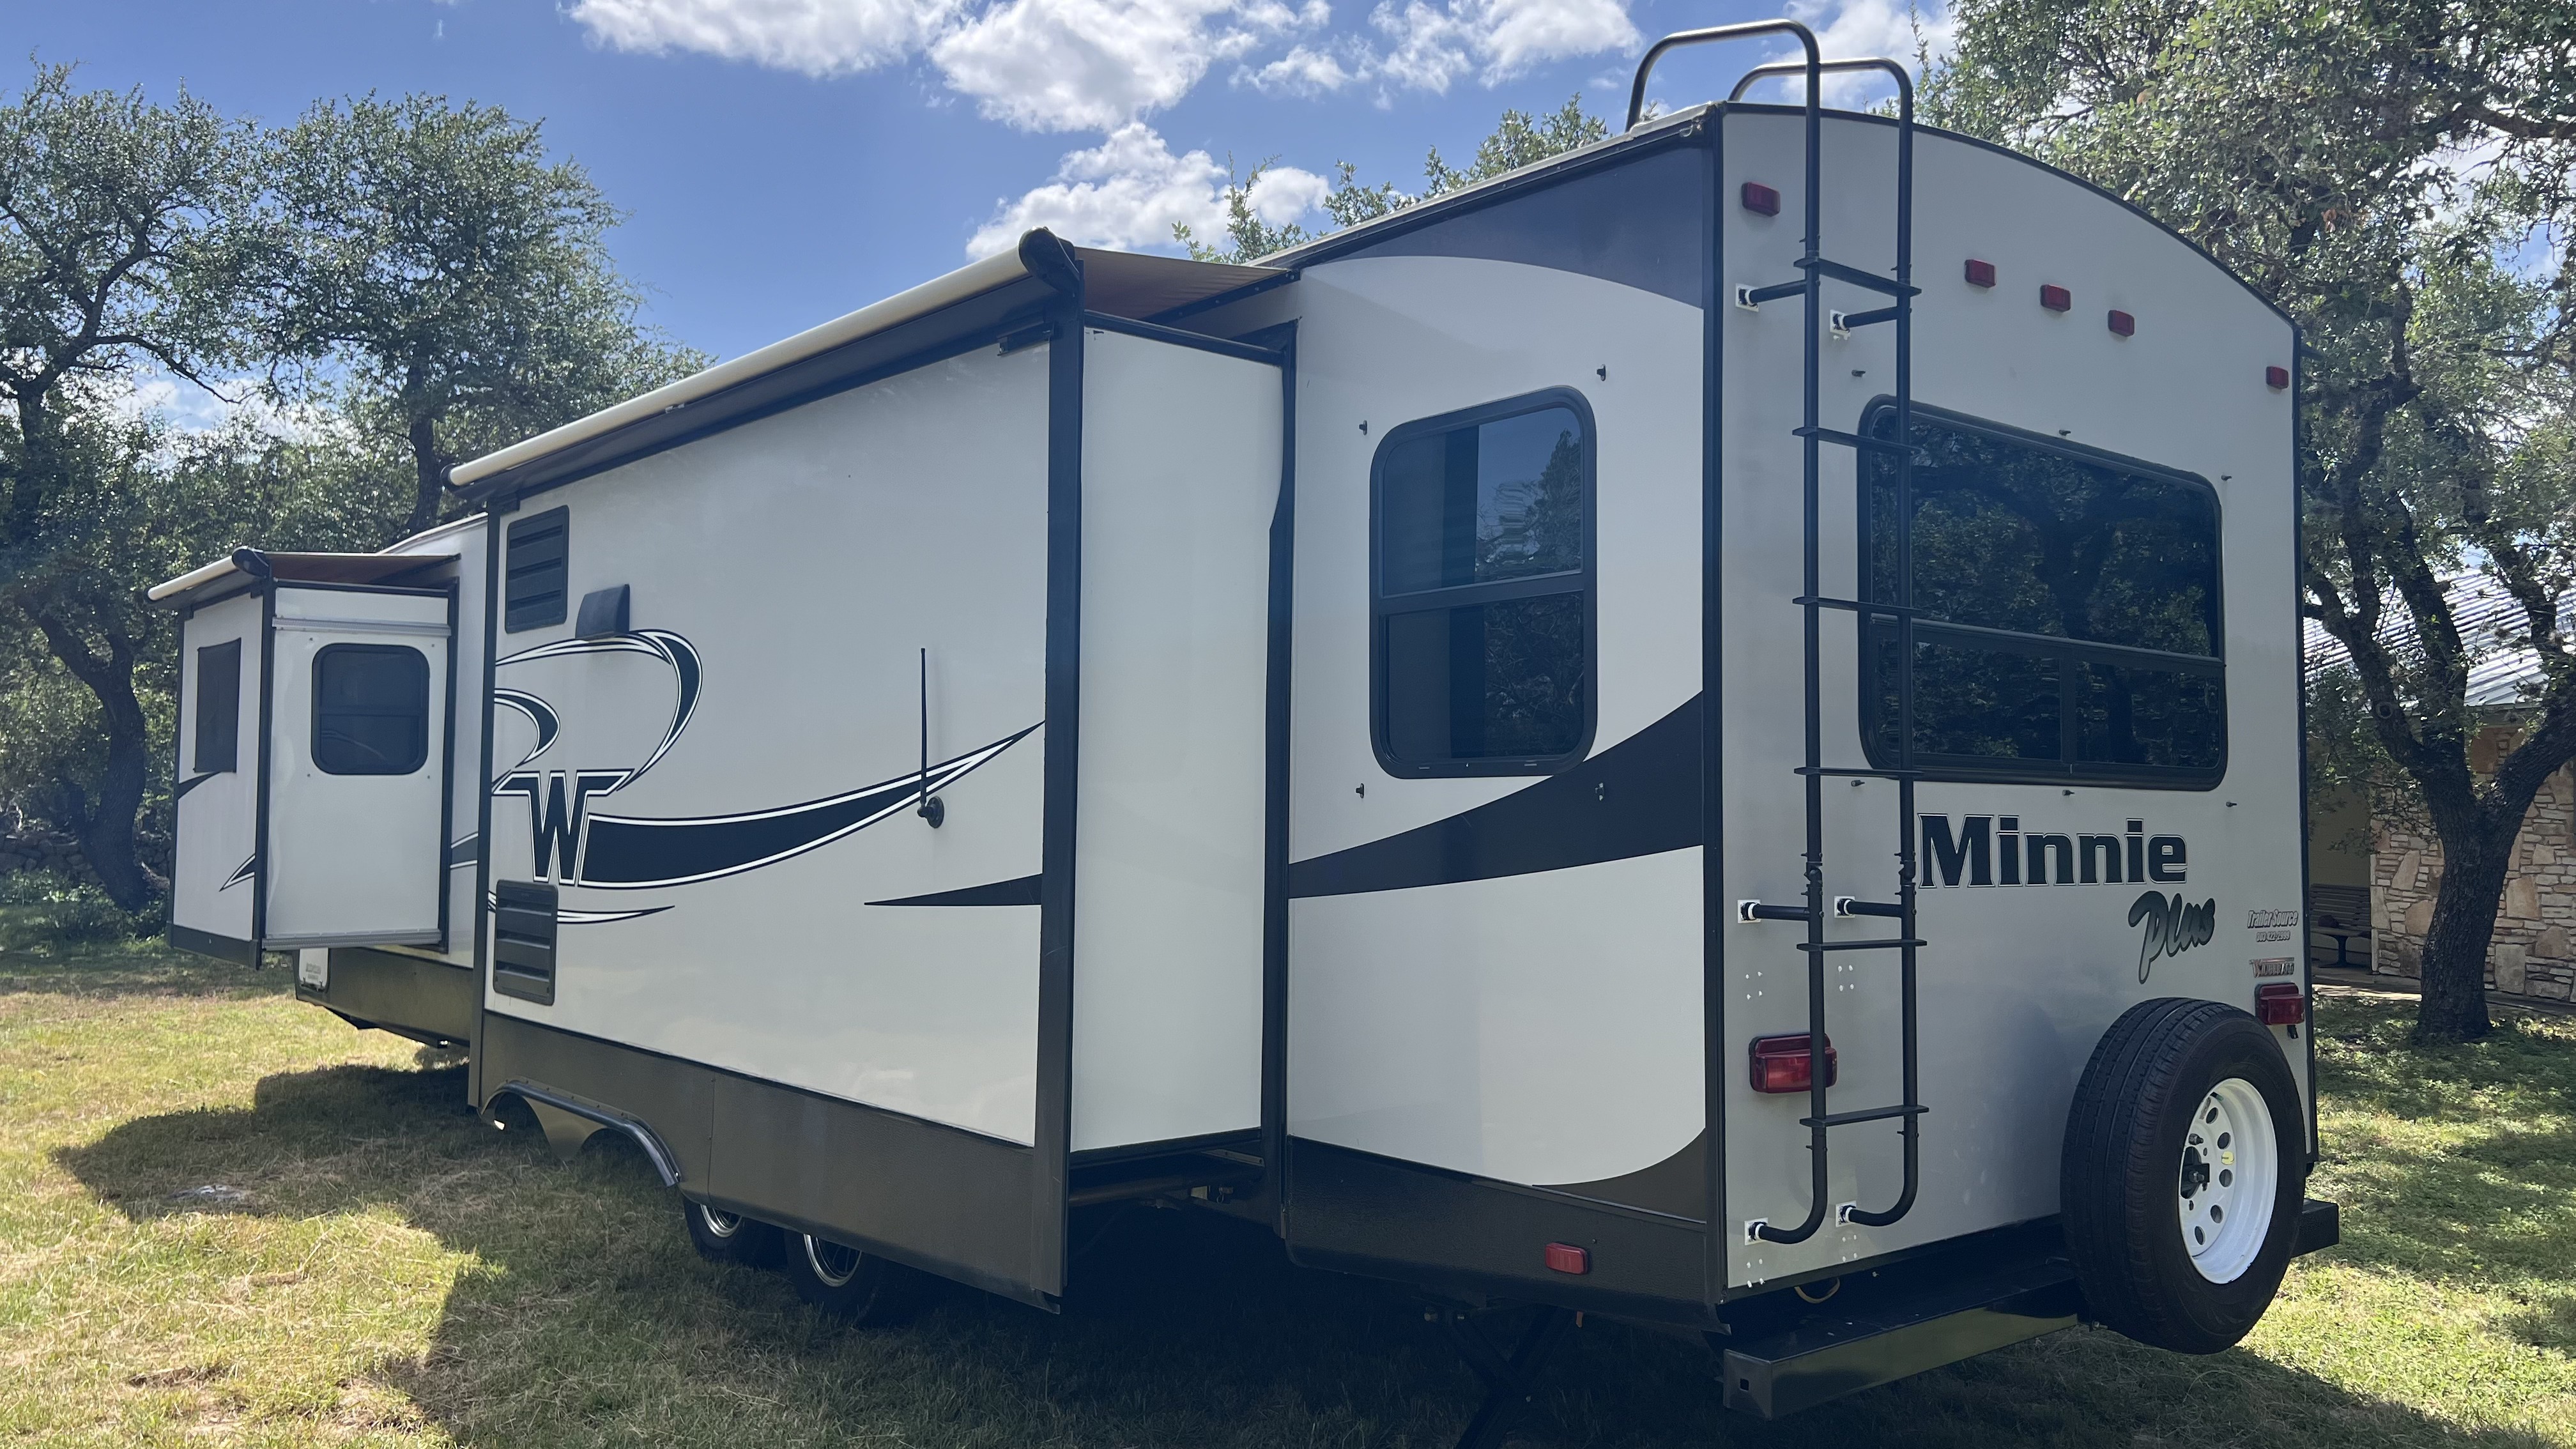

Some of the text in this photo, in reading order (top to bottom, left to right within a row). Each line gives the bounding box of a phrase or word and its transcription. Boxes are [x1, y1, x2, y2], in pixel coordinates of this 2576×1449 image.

[1917, 813, 2188, 889] Minnie
[2128, 891, 2216, 985] Plus
[2248, 909, 2298, 928] Trailer Source
